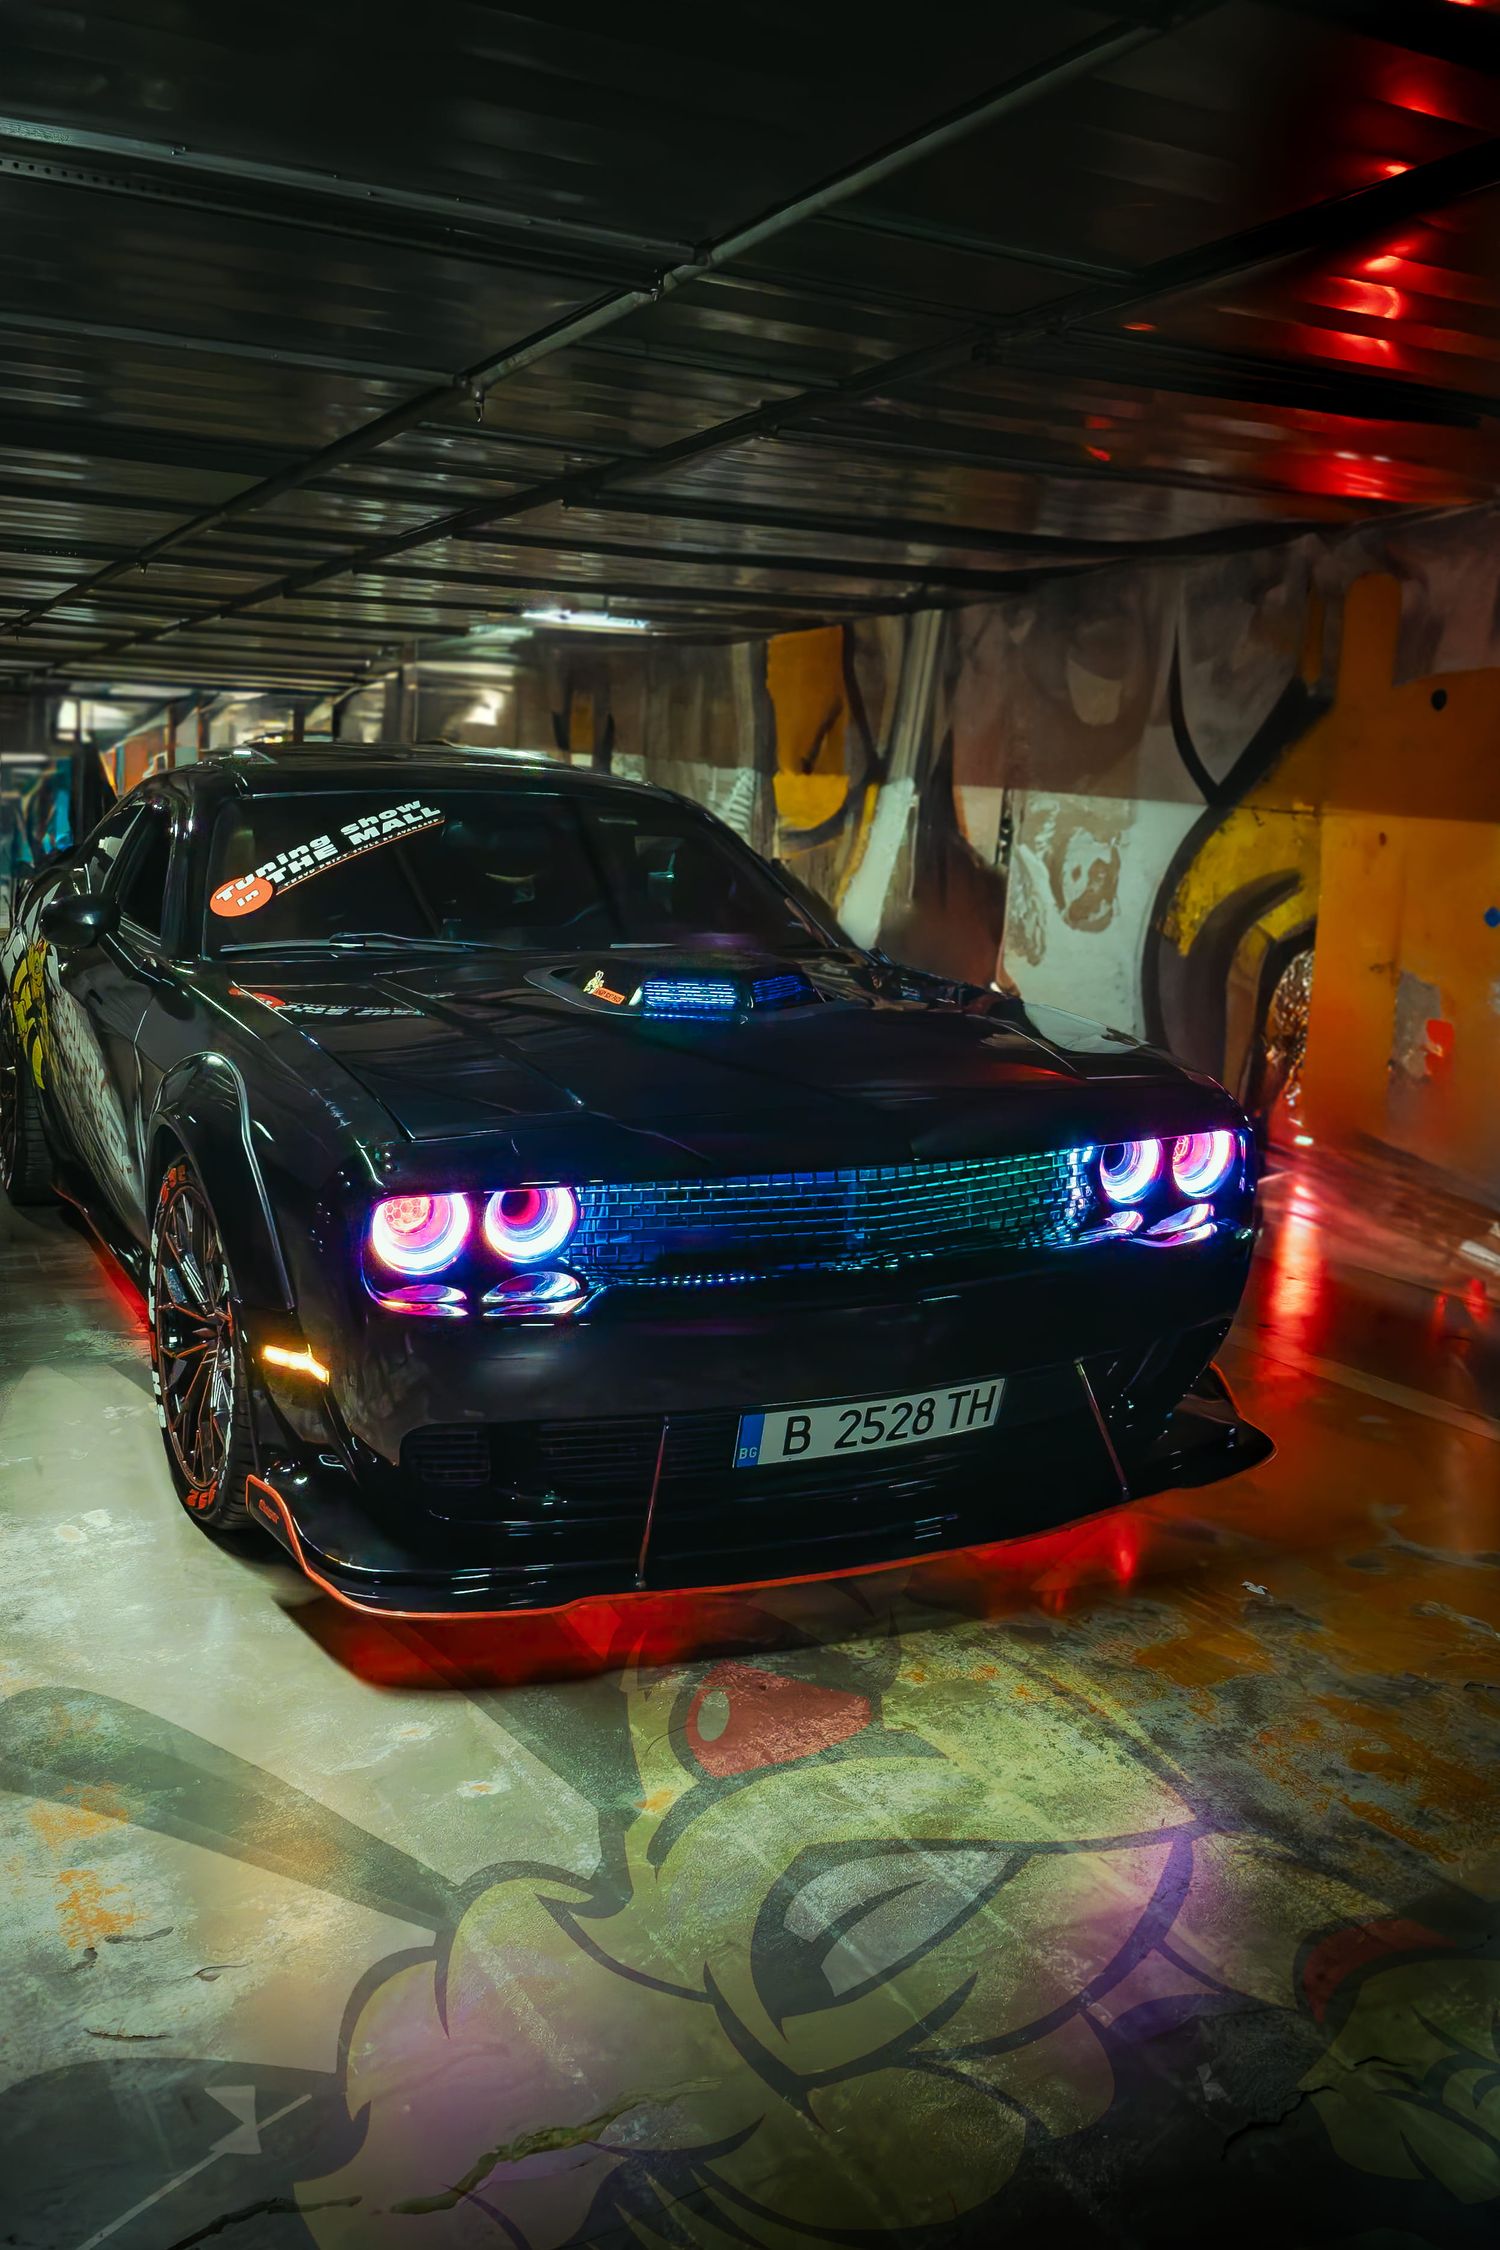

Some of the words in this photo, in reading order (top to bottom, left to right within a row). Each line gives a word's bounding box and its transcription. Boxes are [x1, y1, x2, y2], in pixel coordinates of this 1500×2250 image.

[235, 889, 260, 907] in
[265, 843, 339, 884] THE
[348, 806, 441, 845] MALL
[739, 1447, 758, 1460] BG
[782, 1415, 812, 1456] B
[833, 1397, 936, 1450] 2528
[947, 1385, 998, 1429] TH
